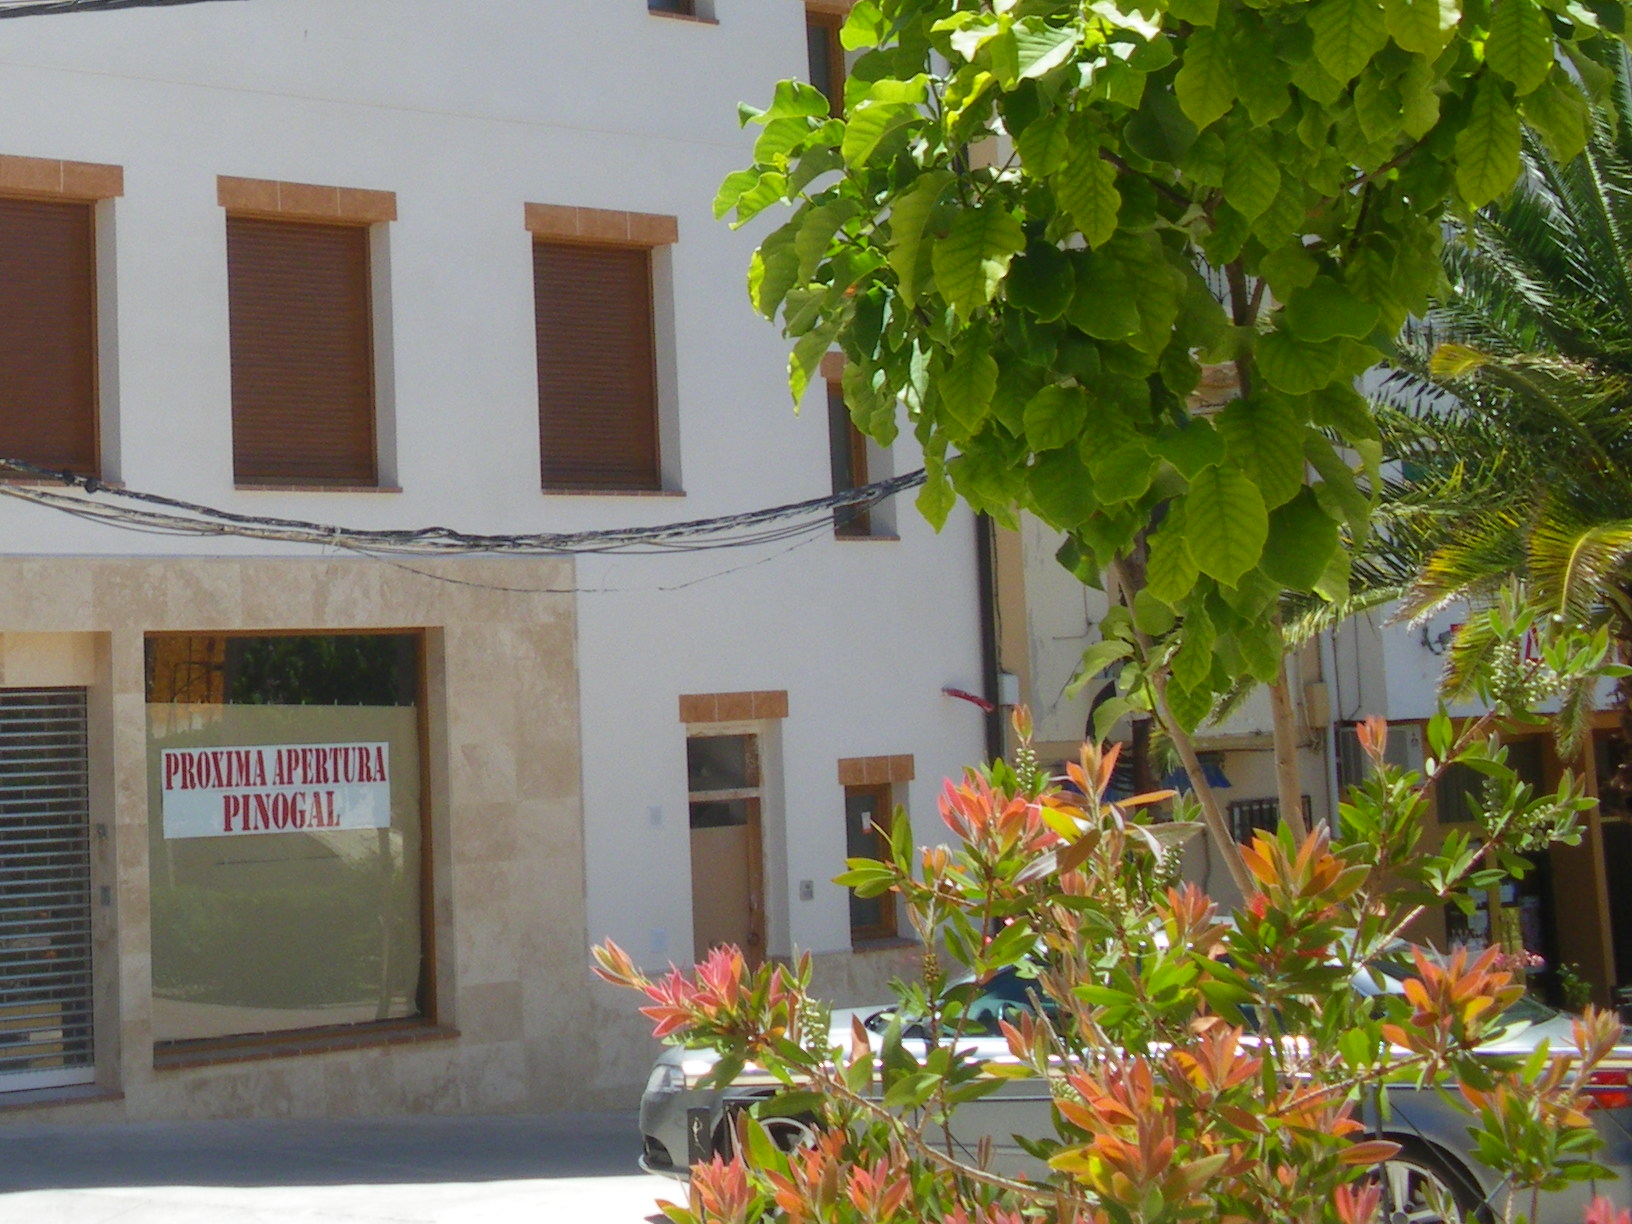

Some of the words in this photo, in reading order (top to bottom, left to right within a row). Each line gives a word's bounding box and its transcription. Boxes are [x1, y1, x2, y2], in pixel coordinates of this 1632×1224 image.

[165, 750, 267, 790] PROXIMA
[272, 746, 386, 786] APERTURA
[223, 791, 340, 832] PINOGAL
